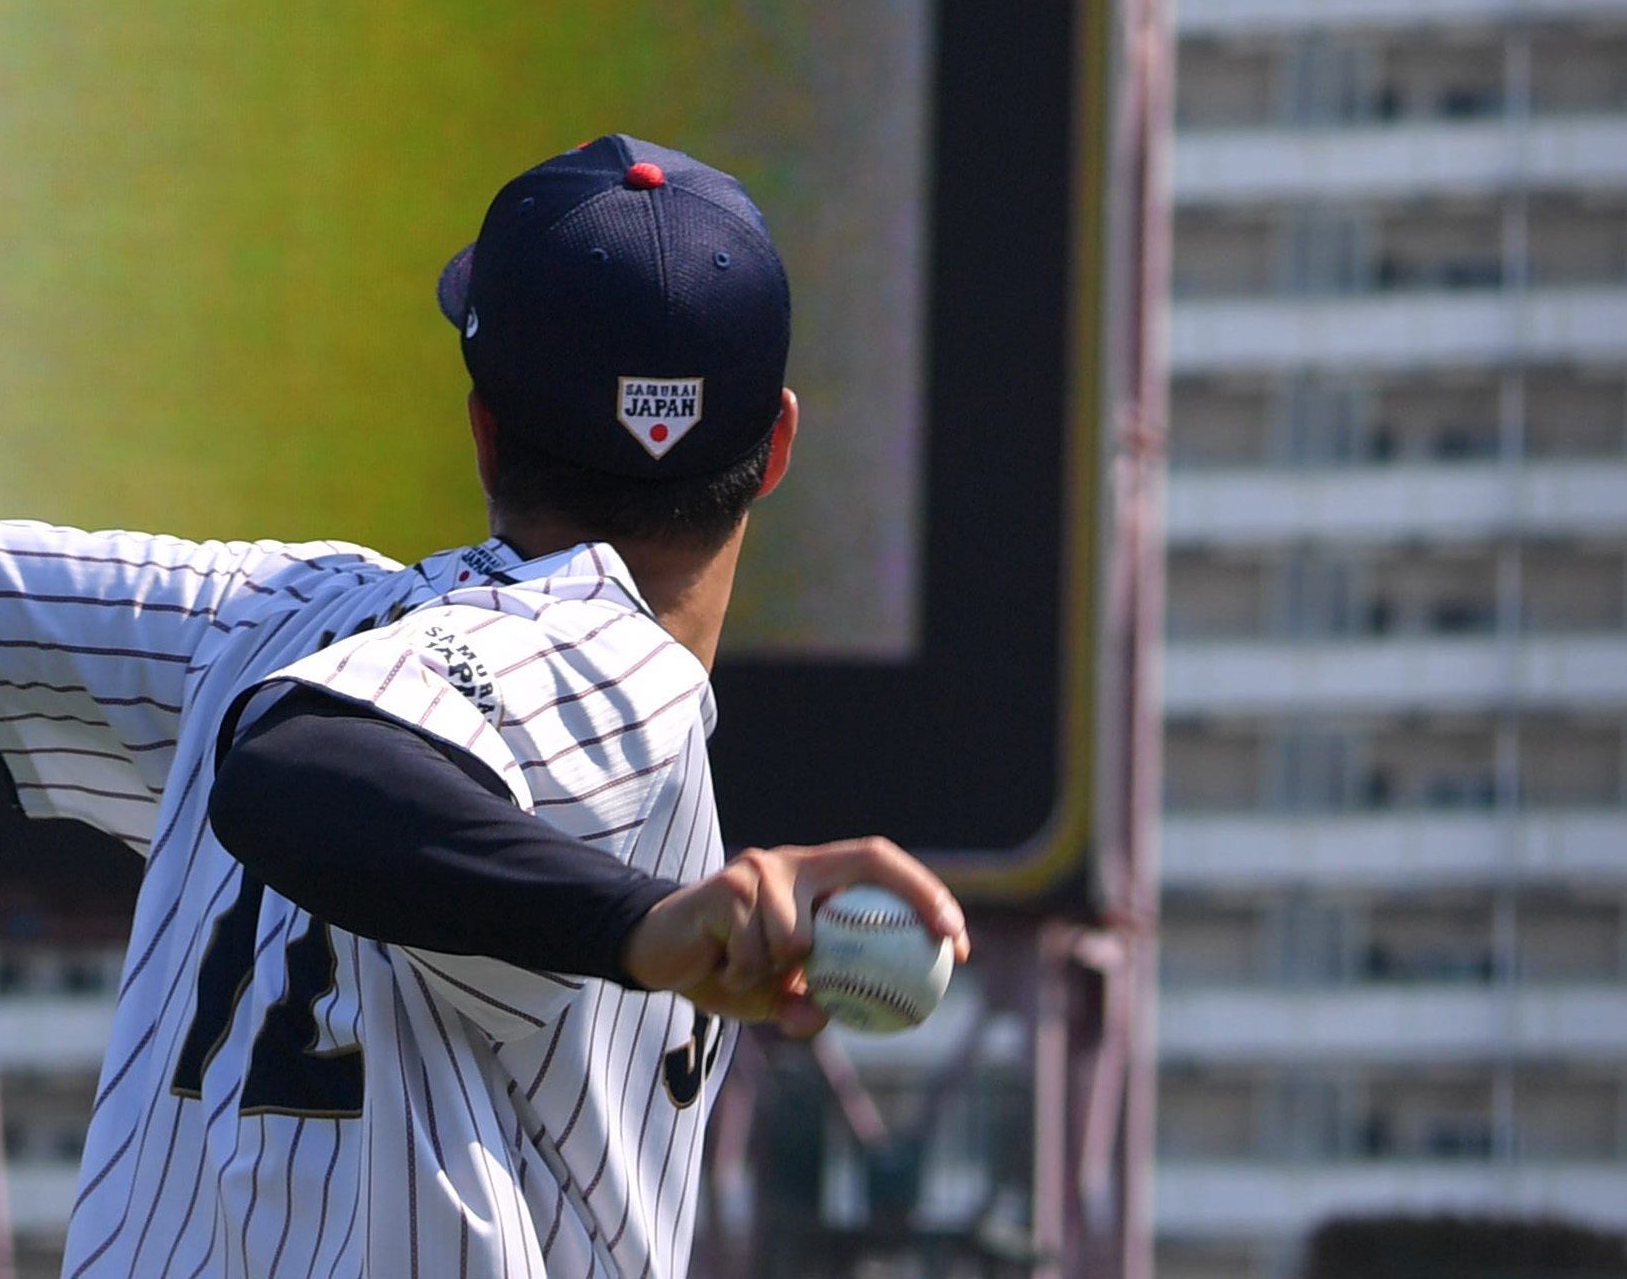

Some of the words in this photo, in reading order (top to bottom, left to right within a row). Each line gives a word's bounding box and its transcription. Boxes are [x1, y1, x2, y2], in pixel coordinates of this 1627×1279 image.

[625, 383, 697, 397] SAMURAI
[624, 398, 695, 418] JAPAN
[425, 627, 495, 724] SAMURA
